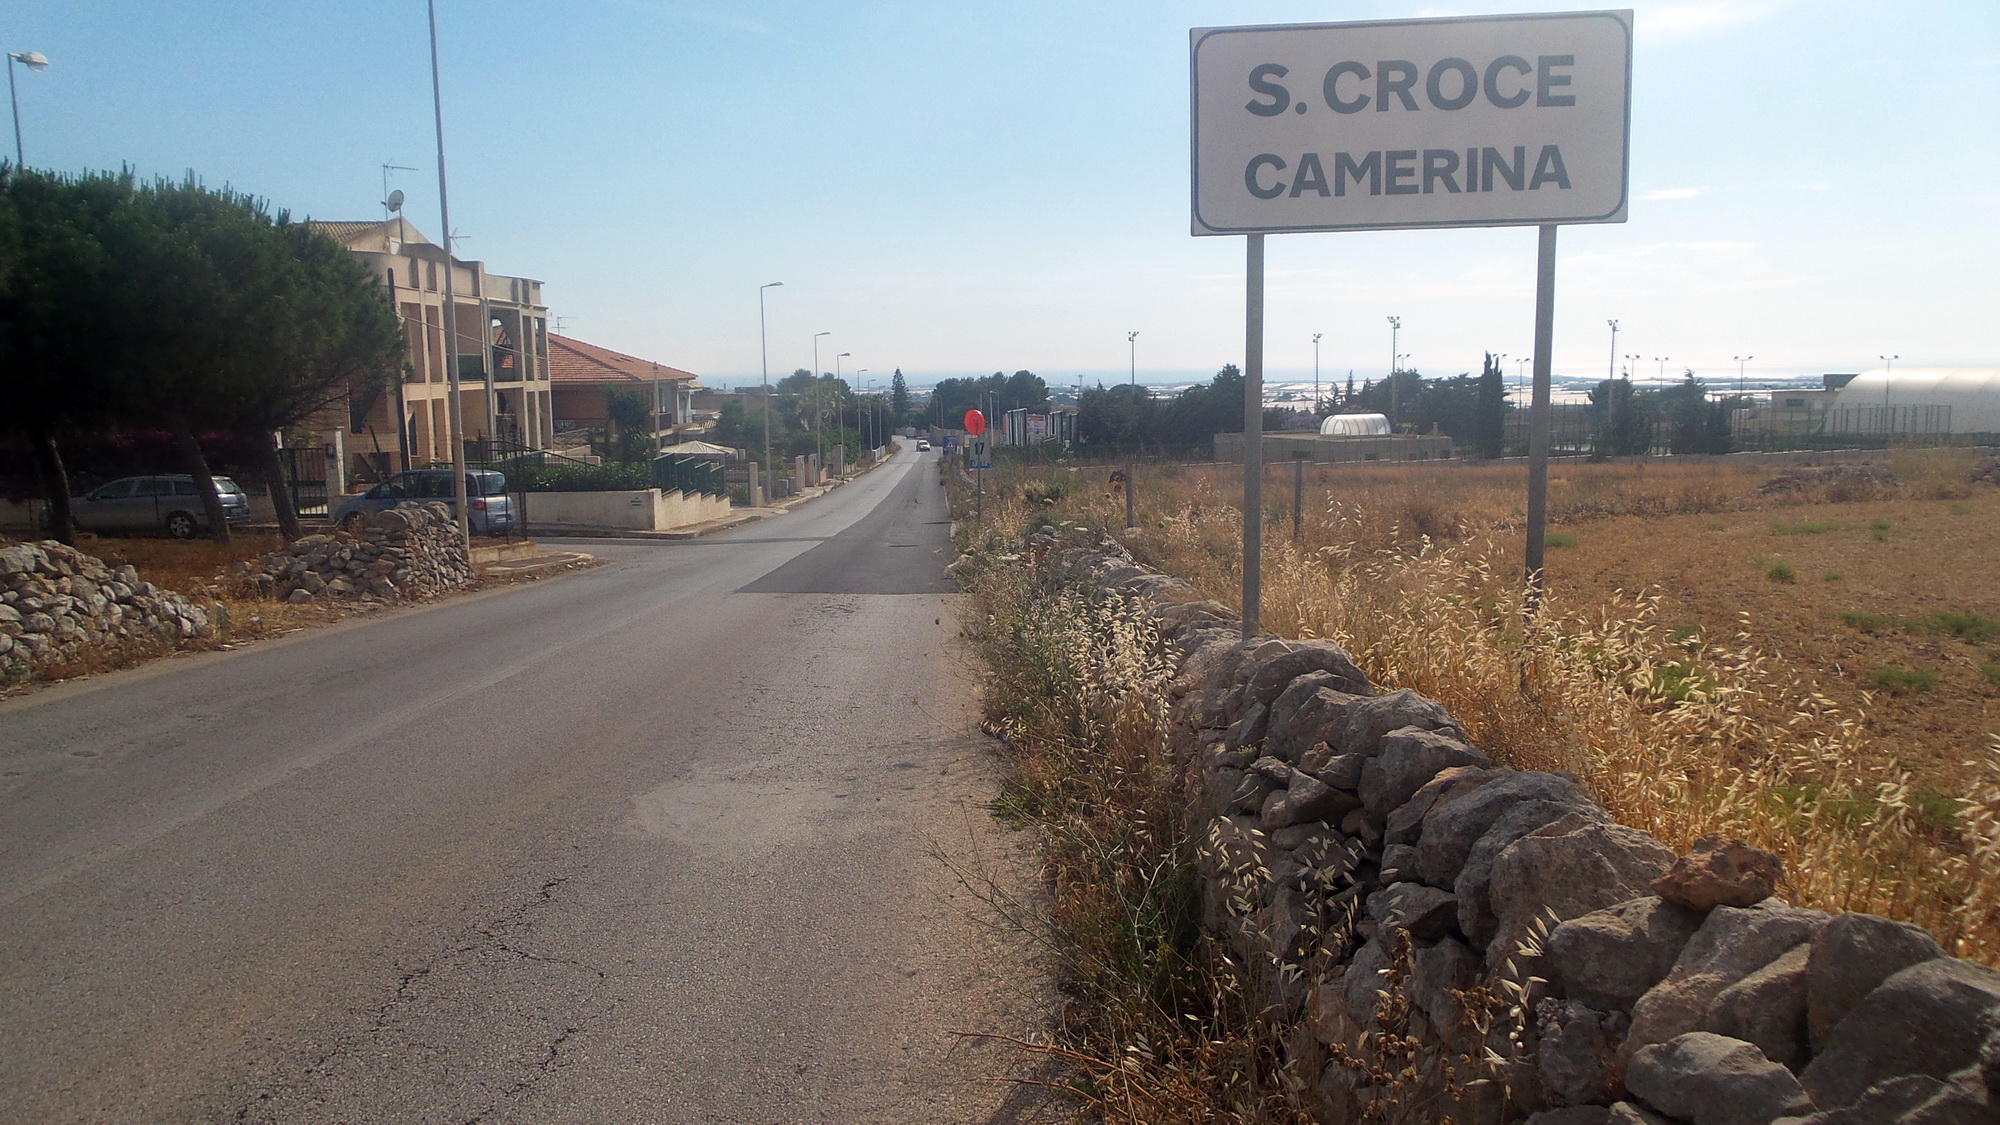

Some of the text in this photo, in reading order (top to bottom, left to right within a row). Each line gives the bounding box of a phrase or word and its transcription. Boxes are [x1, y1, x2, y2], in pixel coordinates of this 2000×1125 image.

[1244, 55, 1576, 117] S. CROCE
[1244, 144, 1572, 200] CAMERINA
[974, 442, 985, 455] 17
